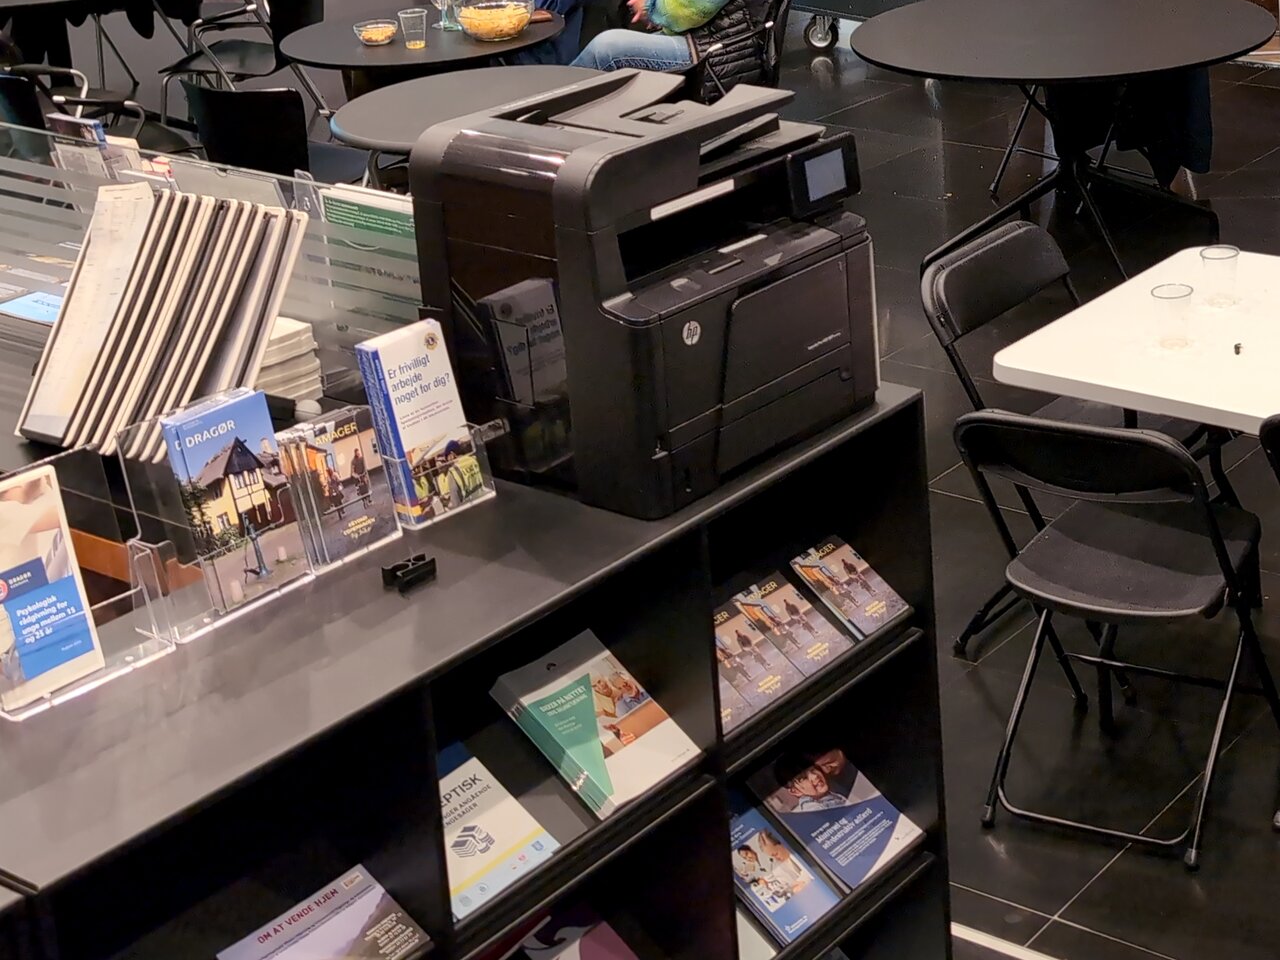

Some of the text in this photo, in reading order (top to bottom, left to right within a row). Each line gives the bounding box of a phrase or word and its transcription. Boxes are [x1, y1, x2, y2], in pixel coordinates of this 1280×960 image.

[387, 354, 431, 380] Er frivilligt
[392, 373, 422, 393] arbejde
[394, 373, 450, 407] noget for dig?
[185, 419, 236, 448] DRAGØR
[16, 595, 57, 617] Psykologisk
[19, 601, 68, 626] rådgivning for
[22, 606, 76, 635] unge mellem 15
[25, 636, 35, 644] og
[45, 626, 53, 635] år
[459, 784, 492, 809] ANGÅENDE
[257, 888, 339, 944] OM AT VENDE HJEM
